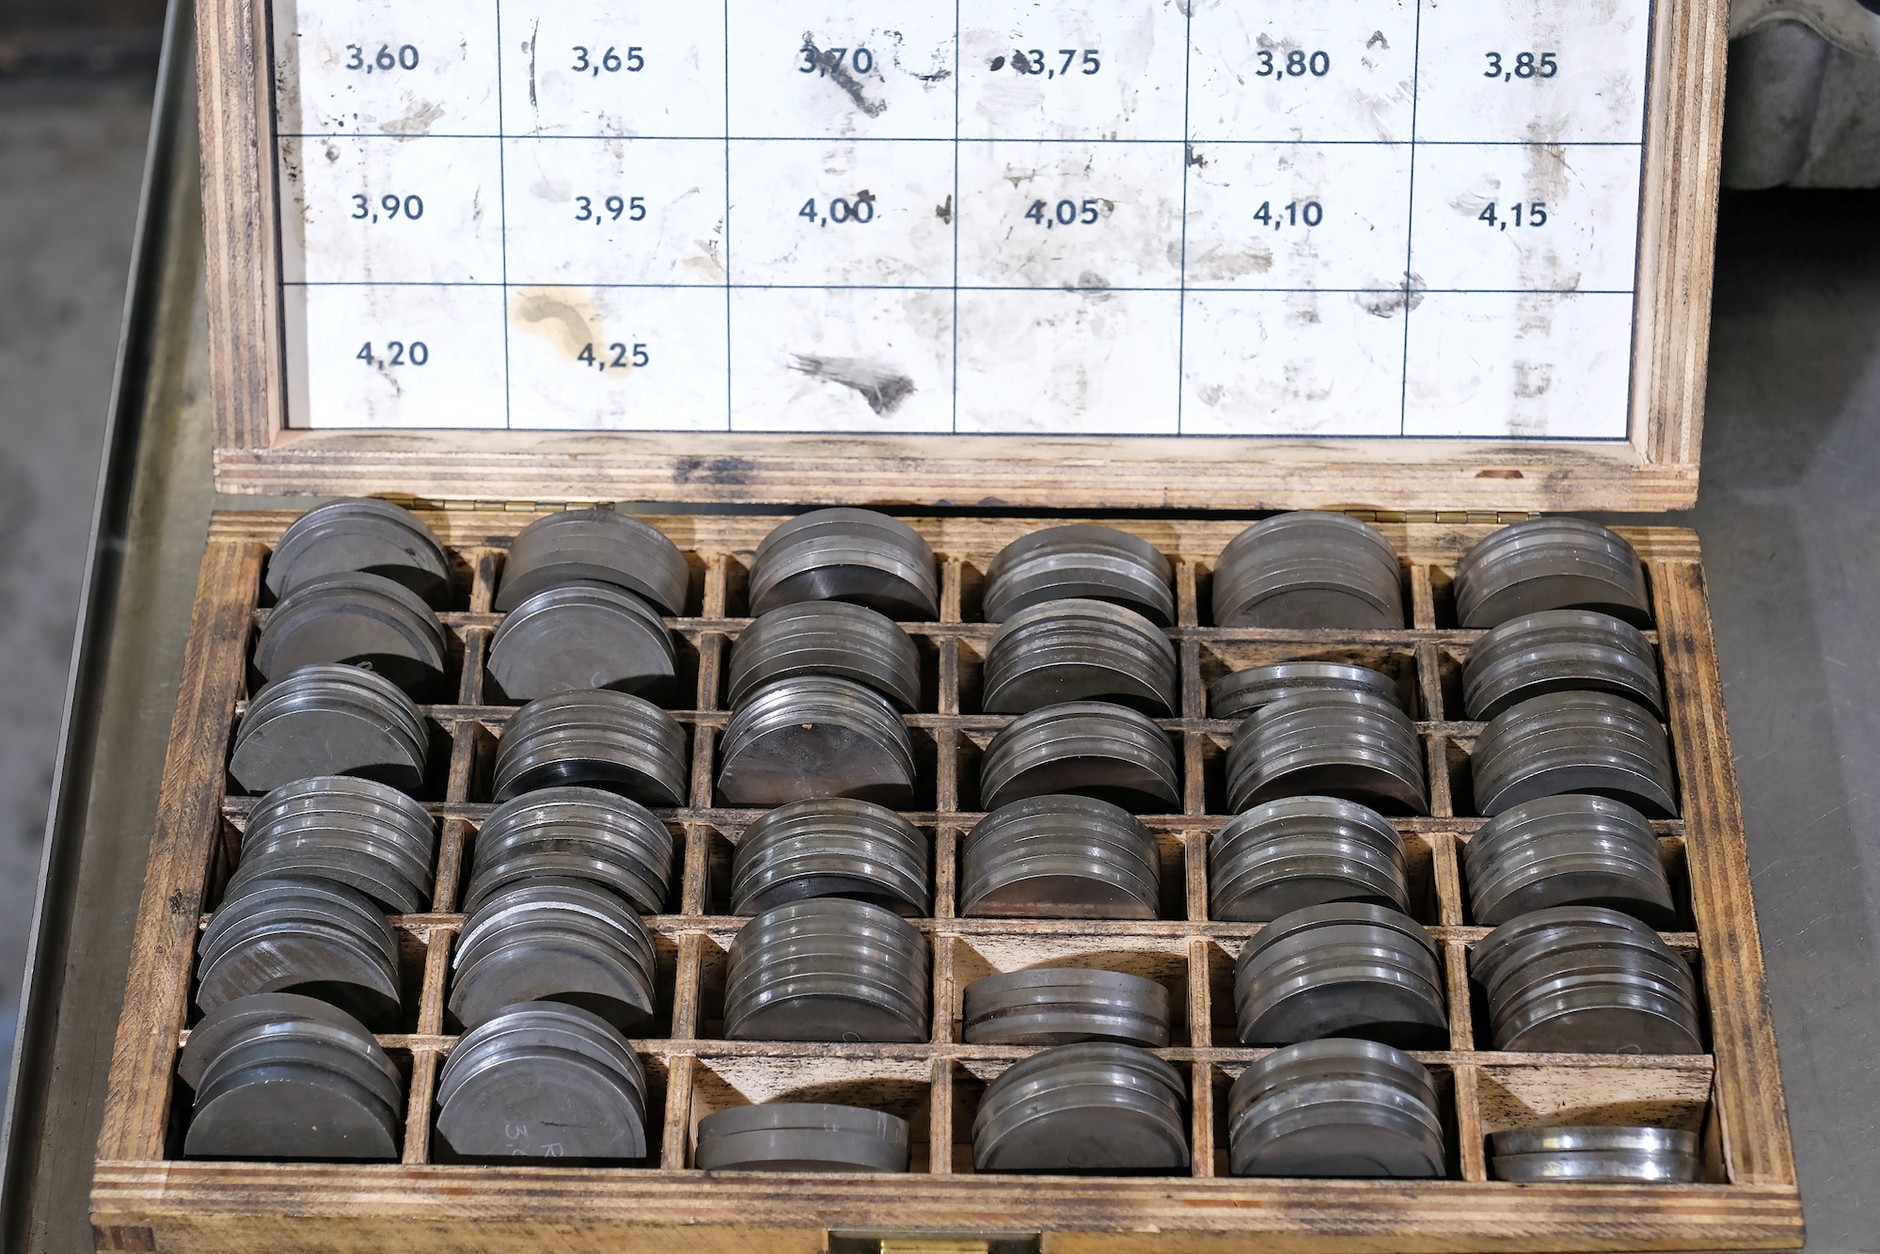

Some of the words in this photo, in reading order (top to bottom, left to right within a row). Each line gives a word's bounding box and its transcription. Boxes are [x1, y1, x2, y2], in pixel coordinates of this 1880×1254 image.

[346, 44, 418, 75] 3,60
[572, 46, 645, 76] 3,65
[799, 47, 873, 78] 3,70
[1027, 49, 1101, 80] 3,75
[1256, 50, 1330, 80] 3,80
[1484, 52, 1558, 82] 3,85
[352, 195, 424, 224] 3,90
[575, 196, 647, 225] 3,95
[798, 198, 874, 228] 4,00
[1024, 200, 1098, 229] 4,05
[1253, 201, 1323, 230] 4,10
[1478, 202, 1548, 231] 4,15
[357, 342, 428, 369] 4,20
[579, 343, 648, 371] 4,25
